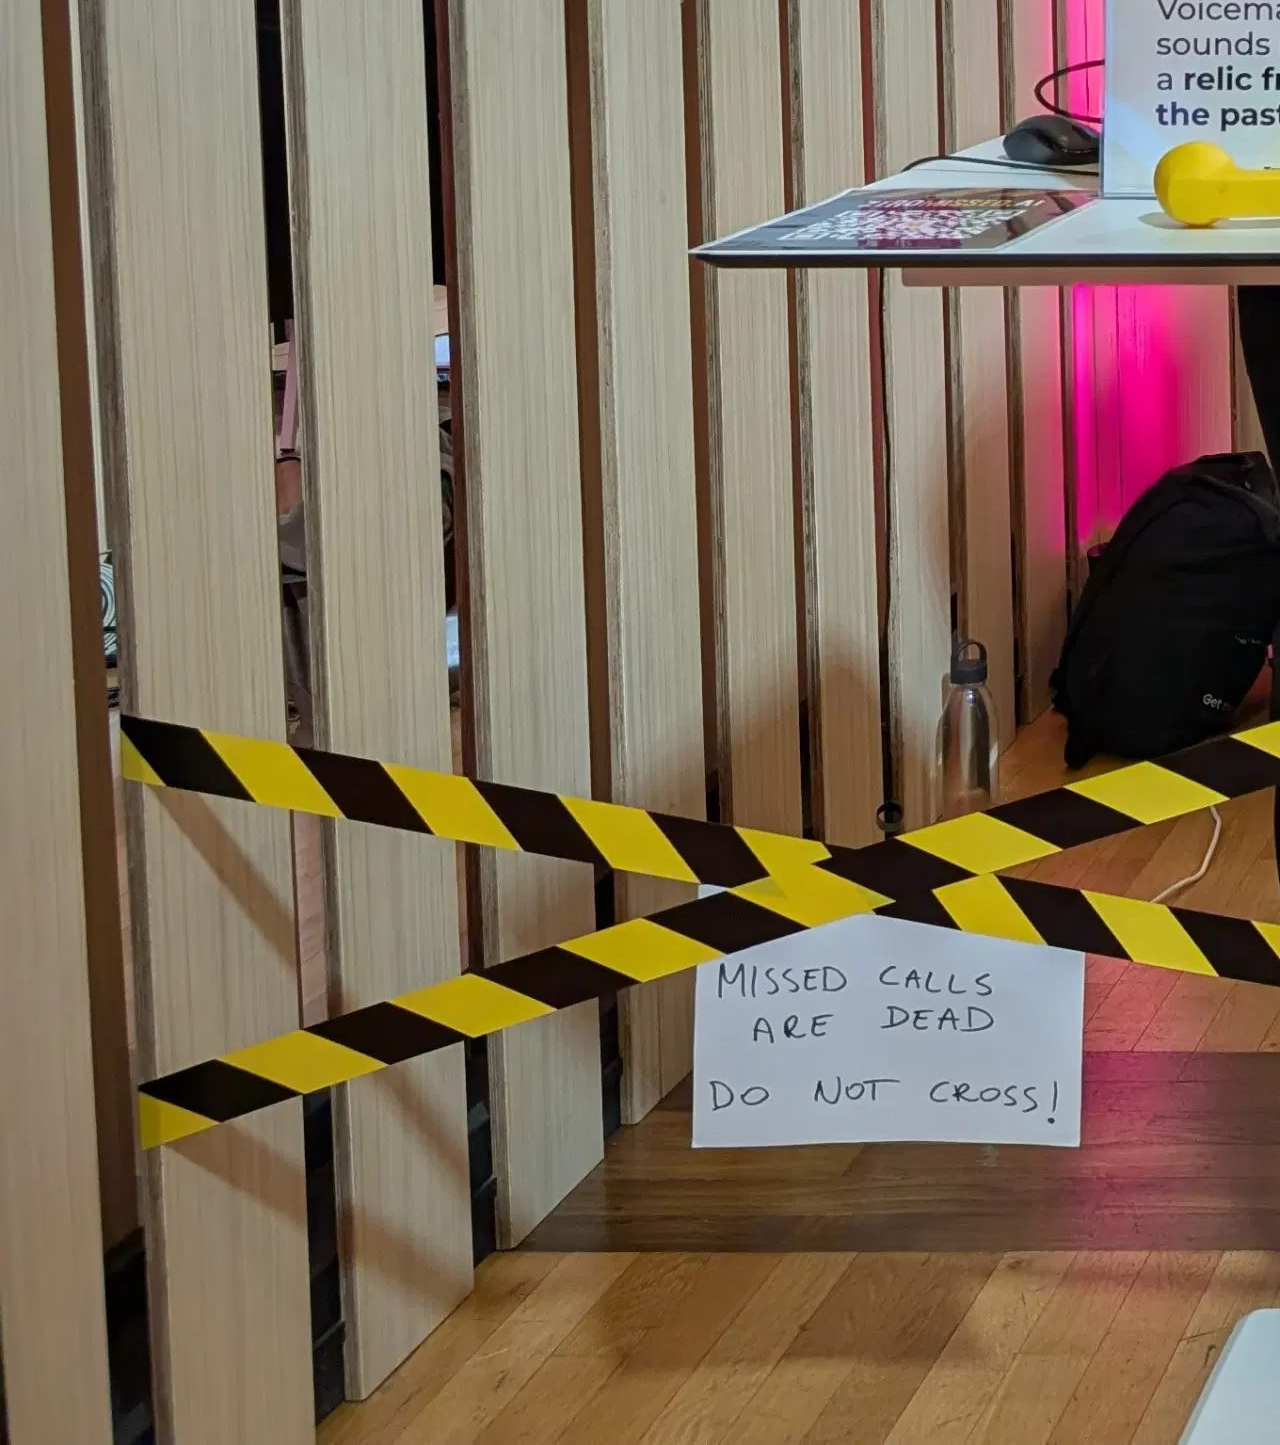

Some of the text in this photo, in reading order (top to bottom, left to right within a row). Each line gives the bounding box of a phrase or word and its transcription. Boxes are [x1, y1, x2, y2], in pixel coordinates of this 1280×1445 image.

[1156, 31, 1270, 56] sounds
[1157, 72, 1173, 91] a
[1184, 65, 1253, 91] relic
[1156, 102, 1210, 126] the
[718, 963, 993, 998] MISSED CALLS
[753, 1006, 994, 1044] ARE DEAD
[709, 1076, 1059, 1125] DO NOT CROSS!
